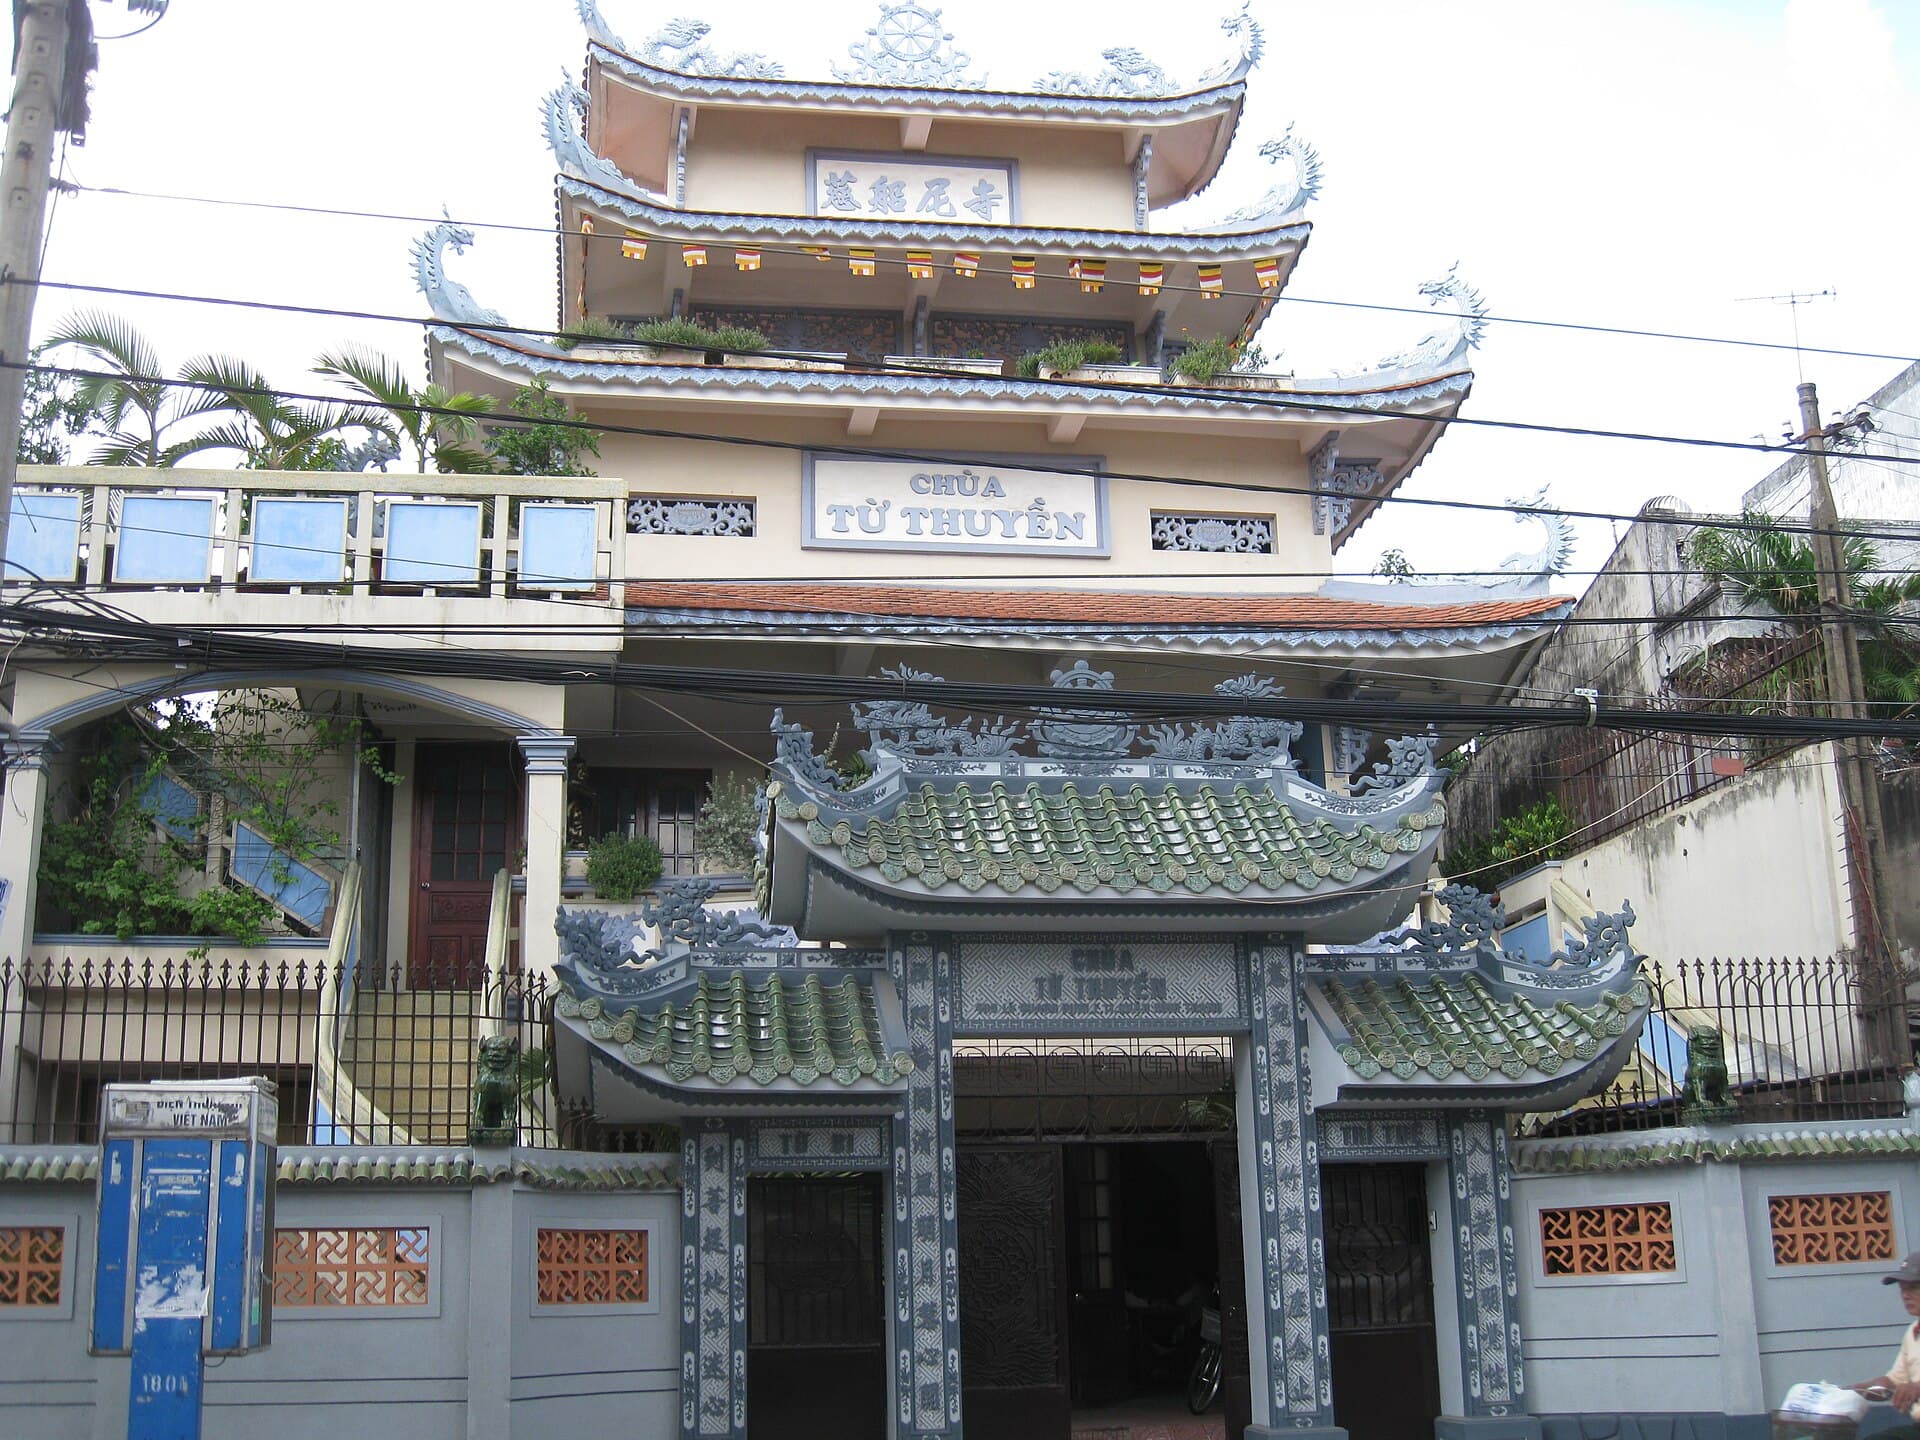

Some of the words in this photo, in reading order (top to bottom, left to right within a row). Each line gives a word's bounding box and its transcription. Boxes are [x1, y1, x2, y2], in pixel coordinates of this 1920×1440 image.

[910, 469, 1006, 497] CHÙA
[826, 498, 890, 533] TỪ
[900, 497, 1085, 540] THUYỀN
